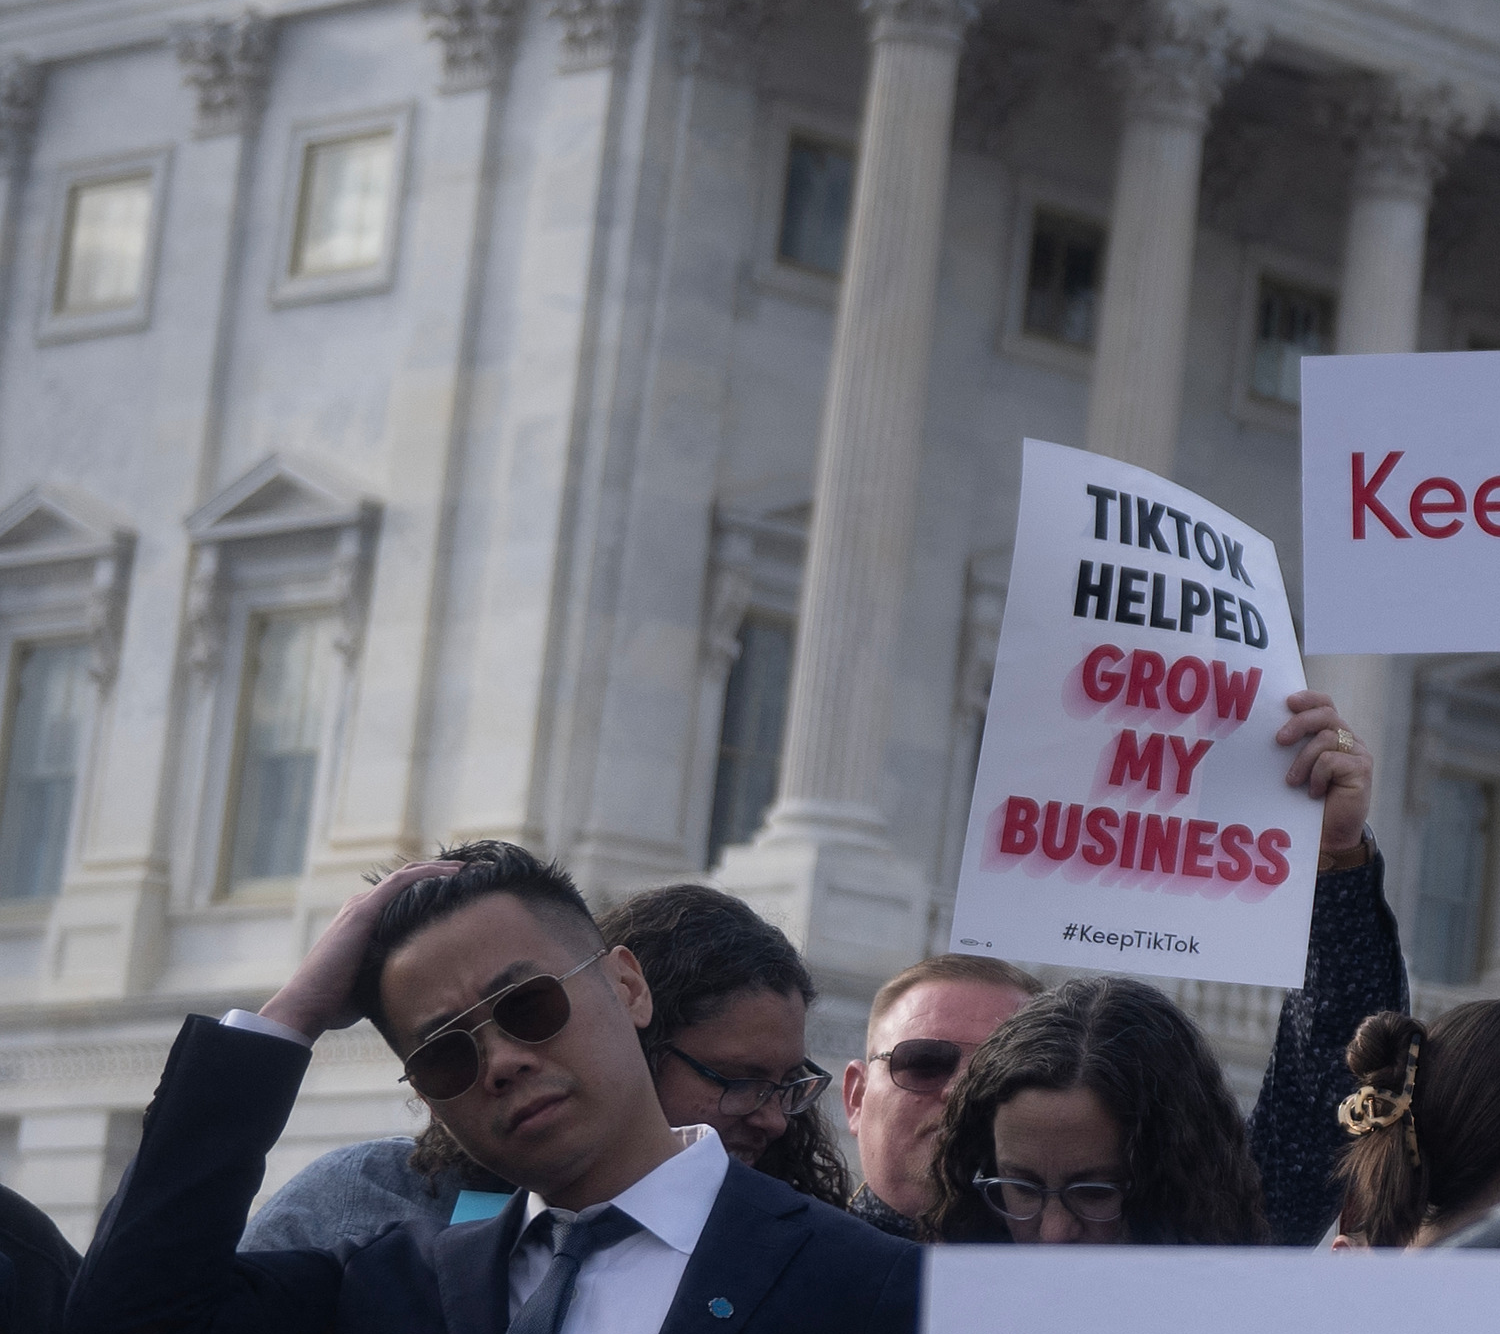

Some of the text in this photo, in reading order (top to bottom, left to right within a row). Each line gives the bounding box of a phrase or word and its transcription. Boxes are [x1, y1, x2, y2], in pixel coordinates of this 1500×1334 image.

[1087, 485, 1250, 585] TIKTOK
[1074, 560, 1266, 648] HELPED
[1083, 647, 1258, 719] GROW
[1109, 732, 1207, 794] MY
[1001, 799, 1287, 885] BUSINESS
[1063, 924, 1198, 953] #KeepTikTok
